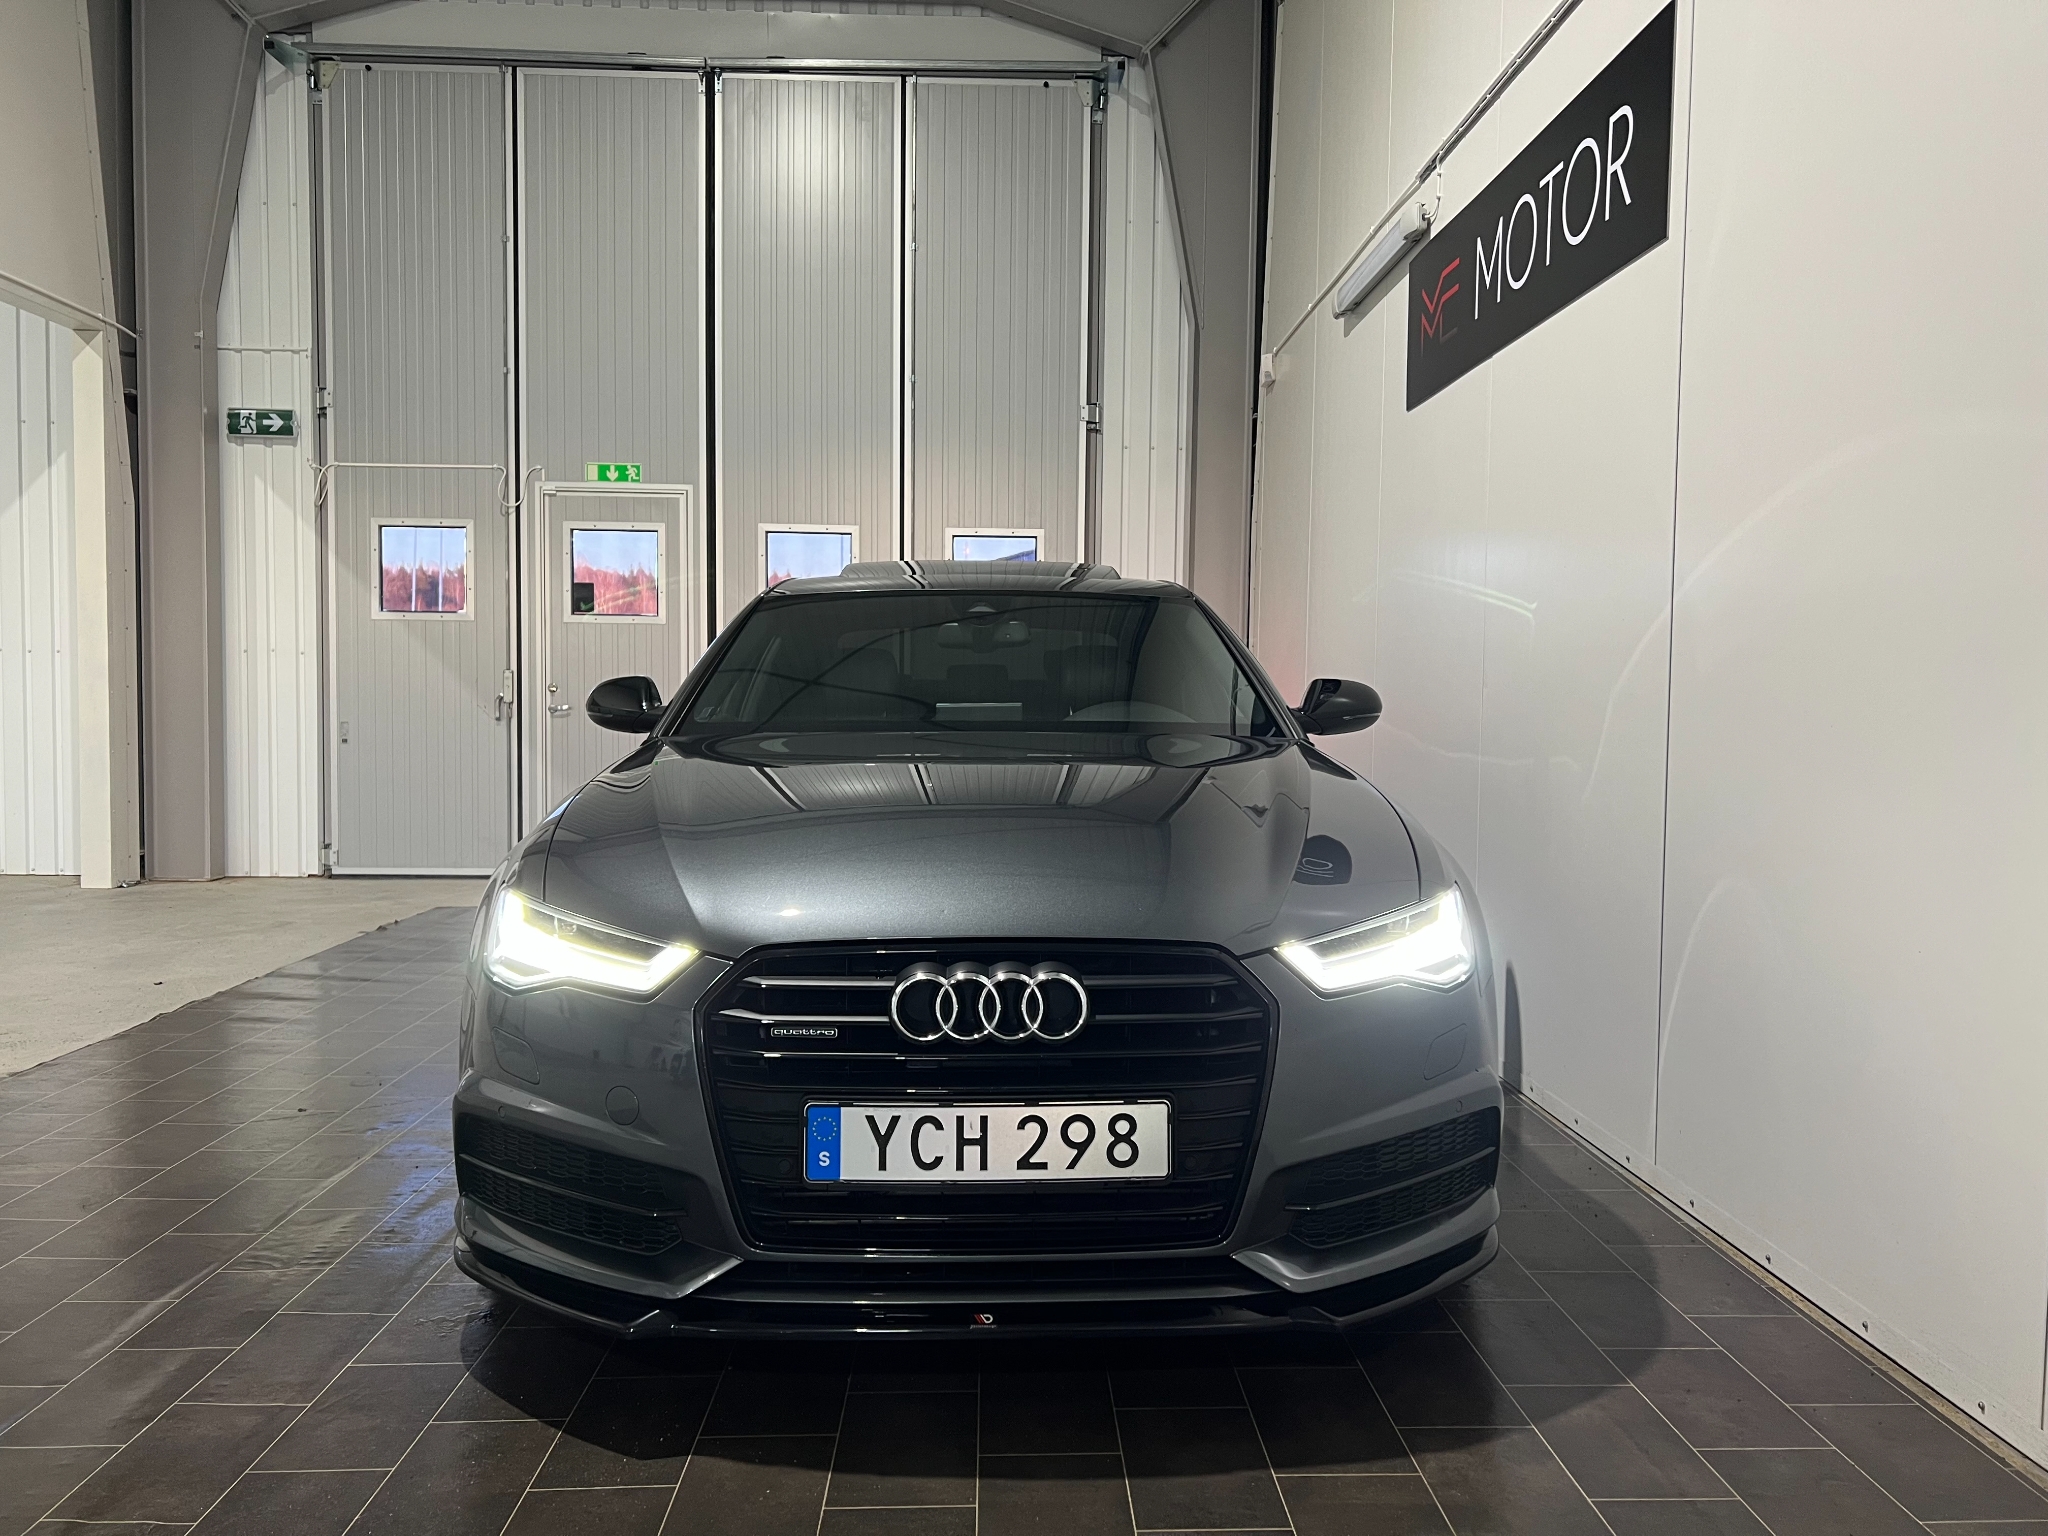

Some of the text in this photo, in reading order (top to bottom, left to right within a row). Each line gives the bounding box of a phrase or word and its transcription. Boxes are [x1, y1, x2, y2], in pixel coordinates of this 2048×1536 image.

[1475, 104, 1634, 320] MOTOR
[774, 1028, 835, 1037] quattro
[818, 1151, 831, 1167] S
[864, 1112, 1140, 1172] YCH 298
